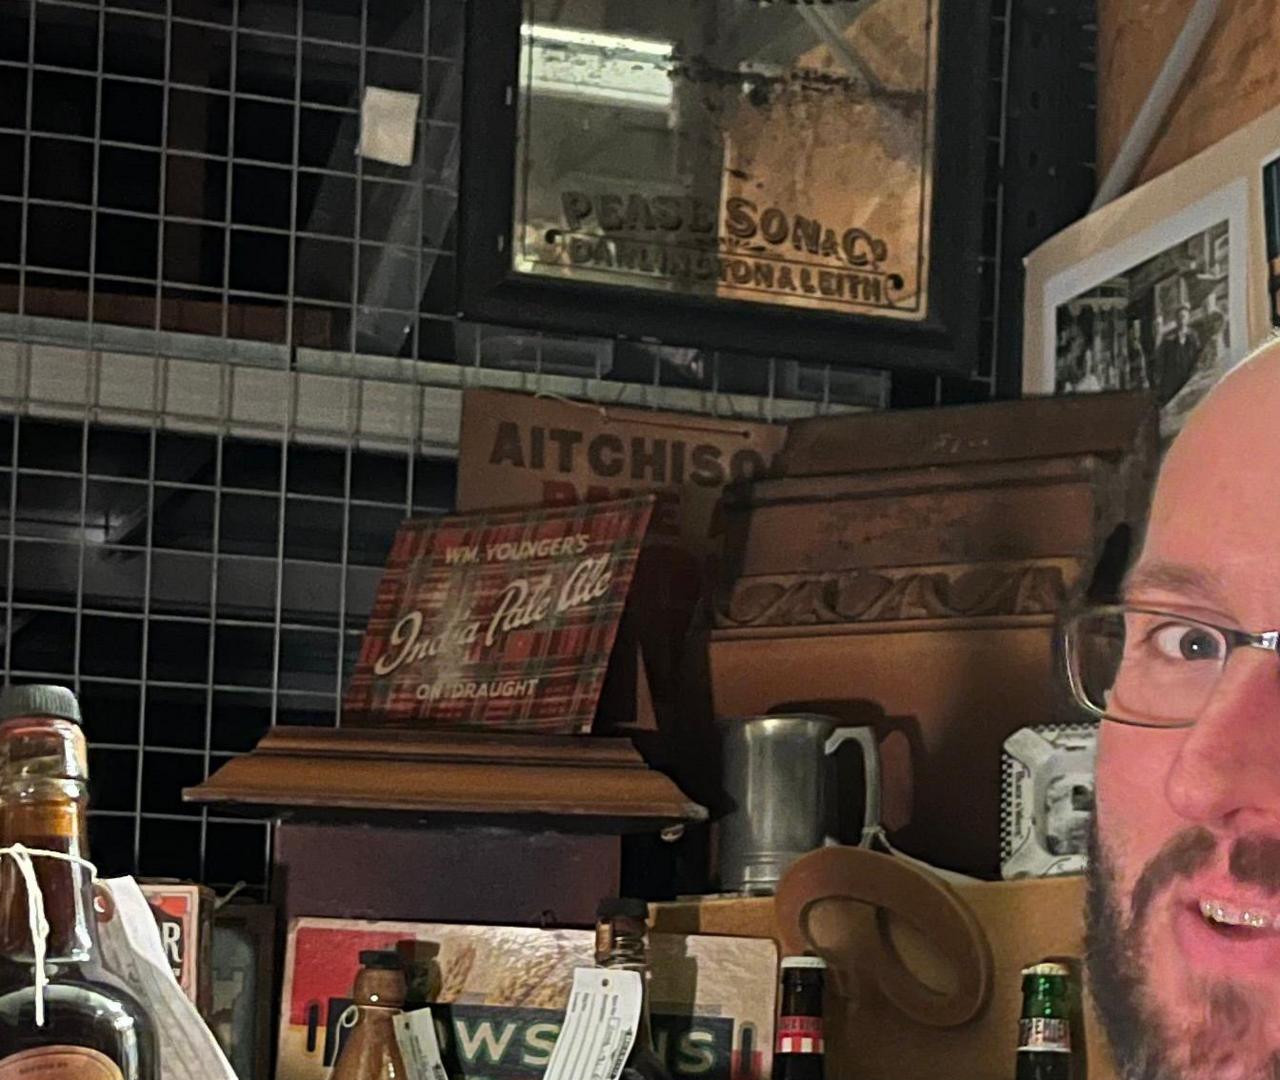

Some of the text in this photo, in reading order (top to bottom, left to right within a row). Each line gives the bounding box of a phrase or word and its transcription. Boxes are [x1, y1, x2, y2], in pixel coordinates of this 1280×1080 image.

[726, 197, 821, 255] SON
[800, 268, 882, 301] LEITH
[487, 534, 589, 560] YOUNGER'S
[486, 574, 553, 647] Pale
[557, 552, 613, 612] Ale
[450, 679, 540, 698] DRAUGHT
